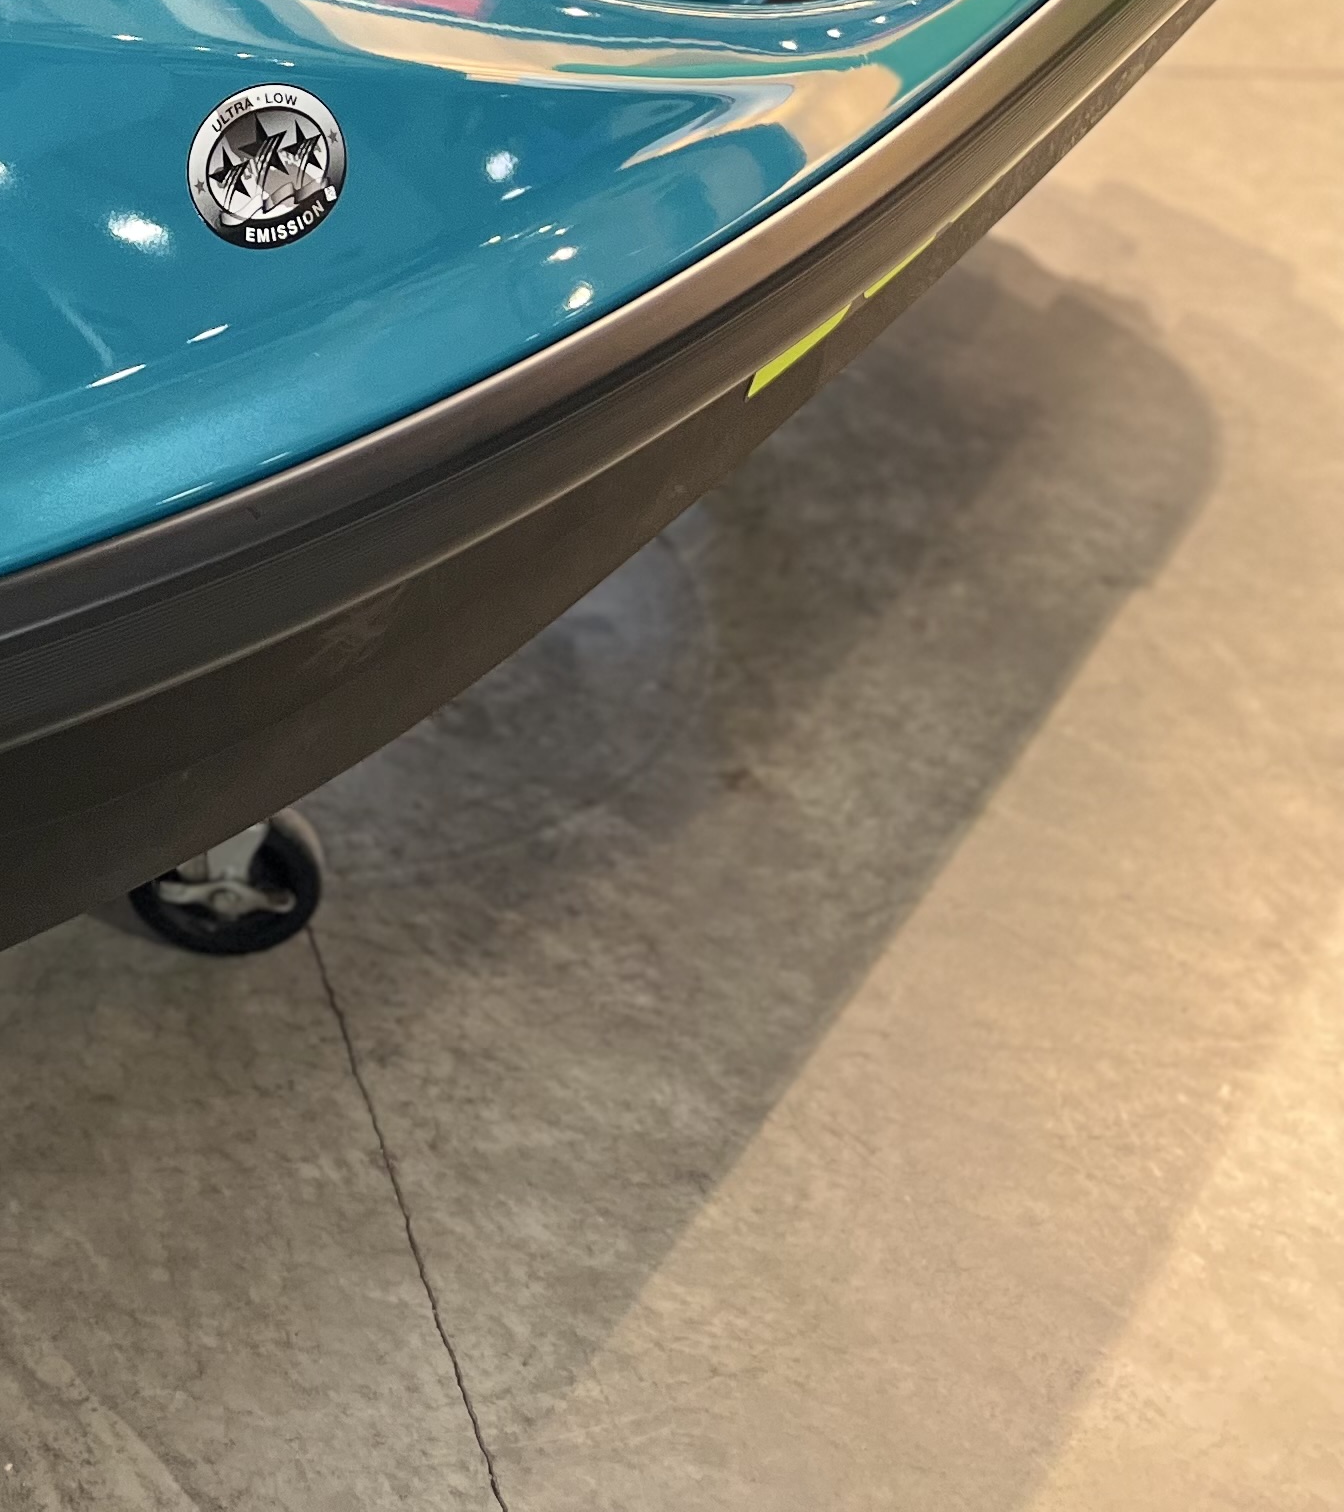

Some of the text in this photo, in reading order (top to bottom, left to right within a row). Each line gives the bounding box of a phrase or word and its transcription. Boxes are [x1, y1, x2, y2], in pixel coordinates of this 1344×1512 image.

[211, 92, 298, 133] ULTRA LOW
[245, 199, 325, 244] EMISSION
